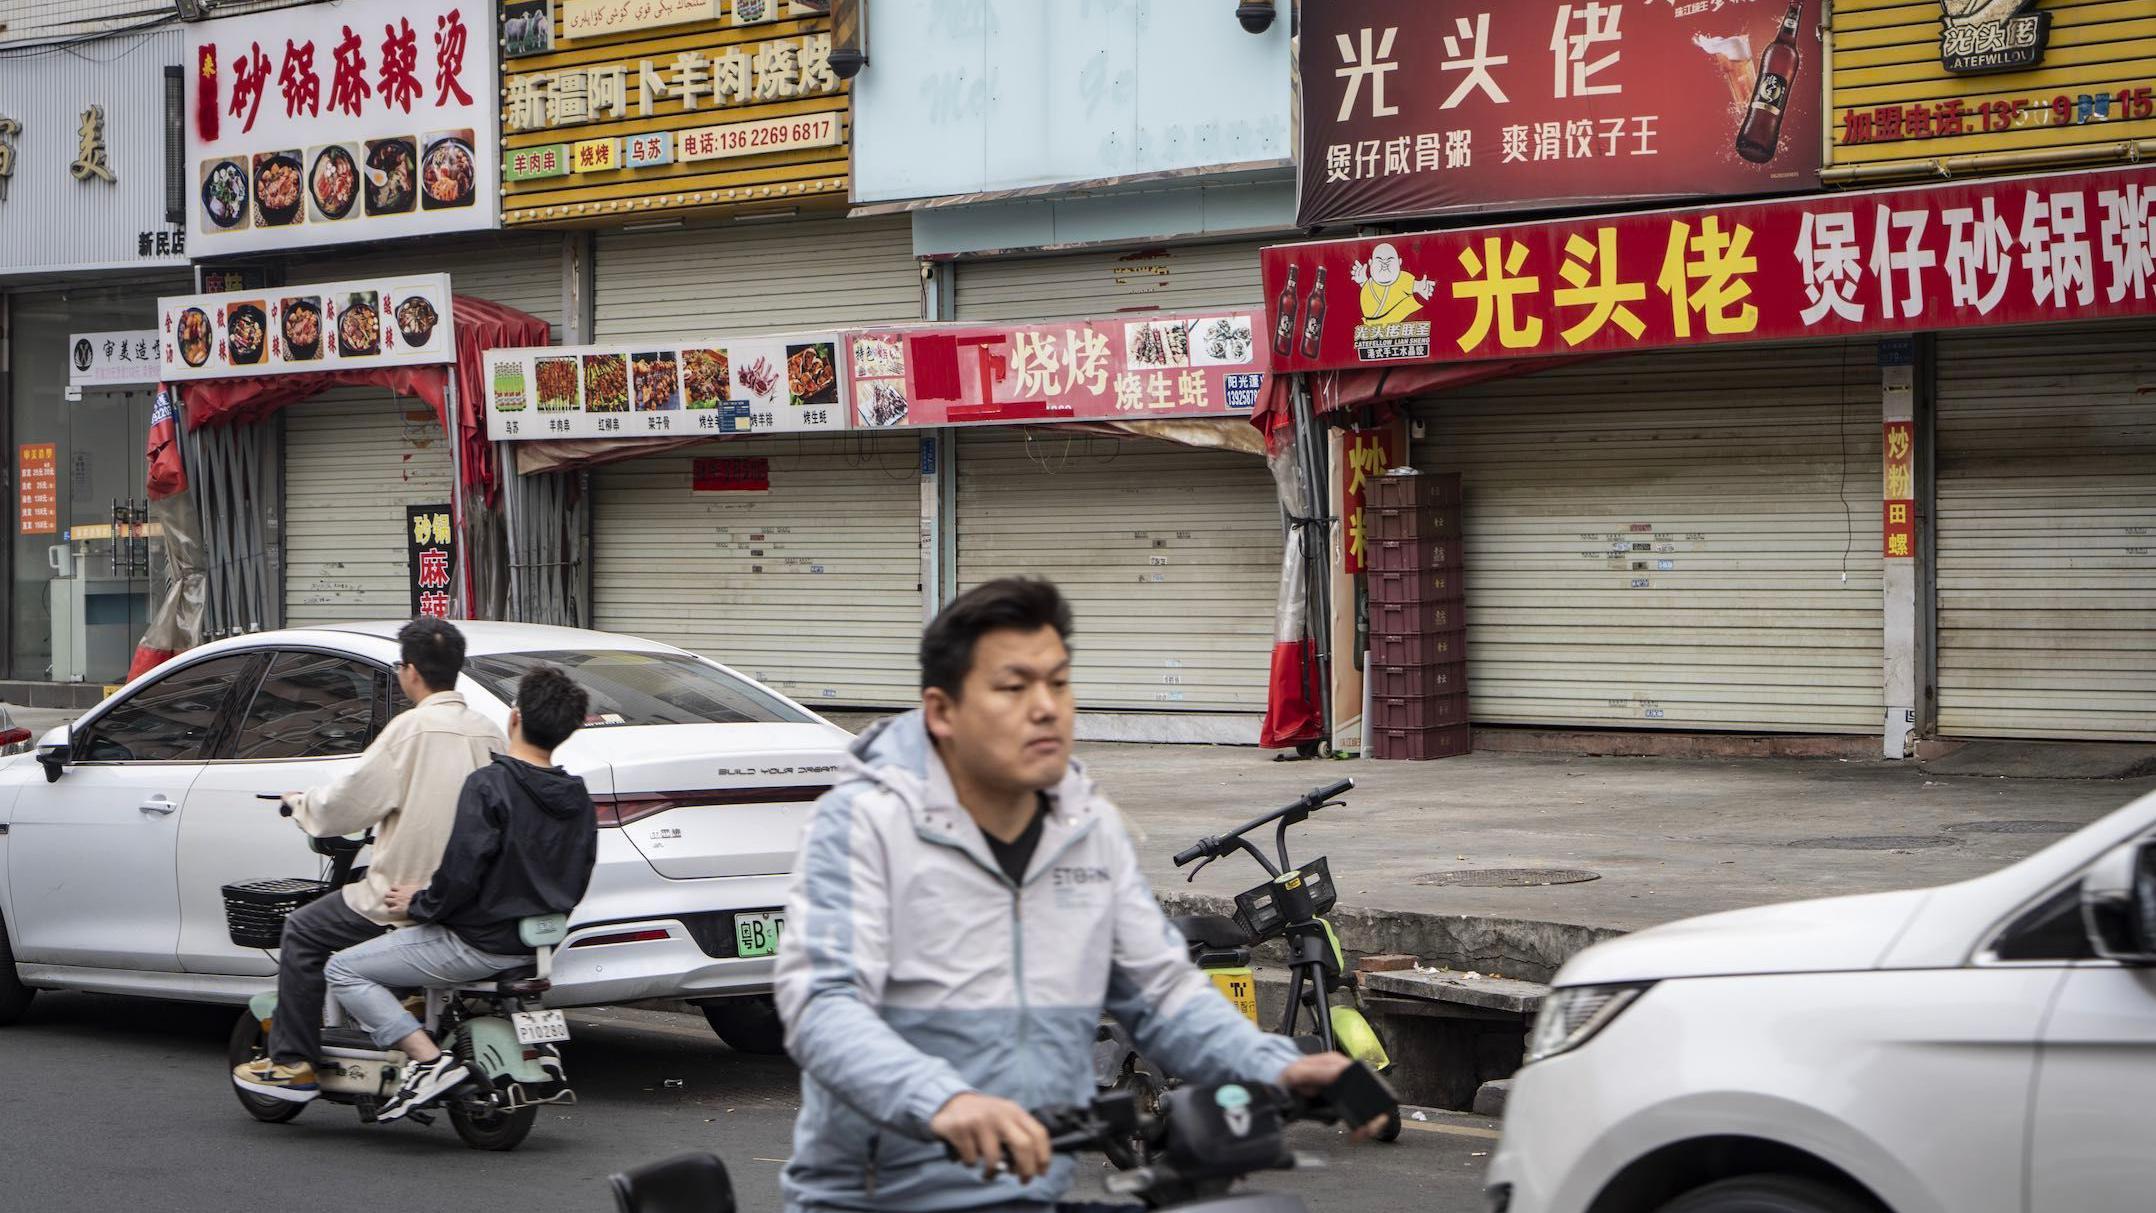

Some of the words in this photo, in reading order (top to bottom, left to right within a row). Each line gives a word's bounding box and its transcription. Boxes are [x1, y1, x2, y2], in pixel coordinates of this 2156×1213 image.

[228, 8, 474, 134] 砂锅麻辣烫
[1335, 2, 1622, 122] 光头佬
[508, 32, 840, 129] 新疆阿卜羊肉烧烤
[580, 144, 609, 167] 烧烤
[632, 138, 662, 161] 乌苏
[1326, 129, 1472, 184] 煲仔咸骨粥
[1501, 115, 1659, 164] 爽滑饺子王
[514, 150, 556, 175] 羊肉串
[138, 229, 185, 256] 新民店
[1793, 183, 2156, 327] 煲仔砂锅粥
[1452, 214, 1759, 353] 光头佬
[1011, 329, 1111, 399] 烧烤
[1367, 346, 1425, 358] 港式手工水晶饺
[1113, 370, 1209, 411] 烧生蚝
[506, 420, 519, 434] 乌苏
[550, 419, 570, 432] 羊肉串
[750, 411, 773, 427] 烤羊排
[803, 410, 827, 424] 烤生蚝
[1888, 426, 1910, 497] 炒粉
[414, 513, 451, 545] 砂锅
[1888, 504, 1908, 555] 田螺
[718, 768, 756, 776] BUILD
[760, 767, 794, 775] YOUR
